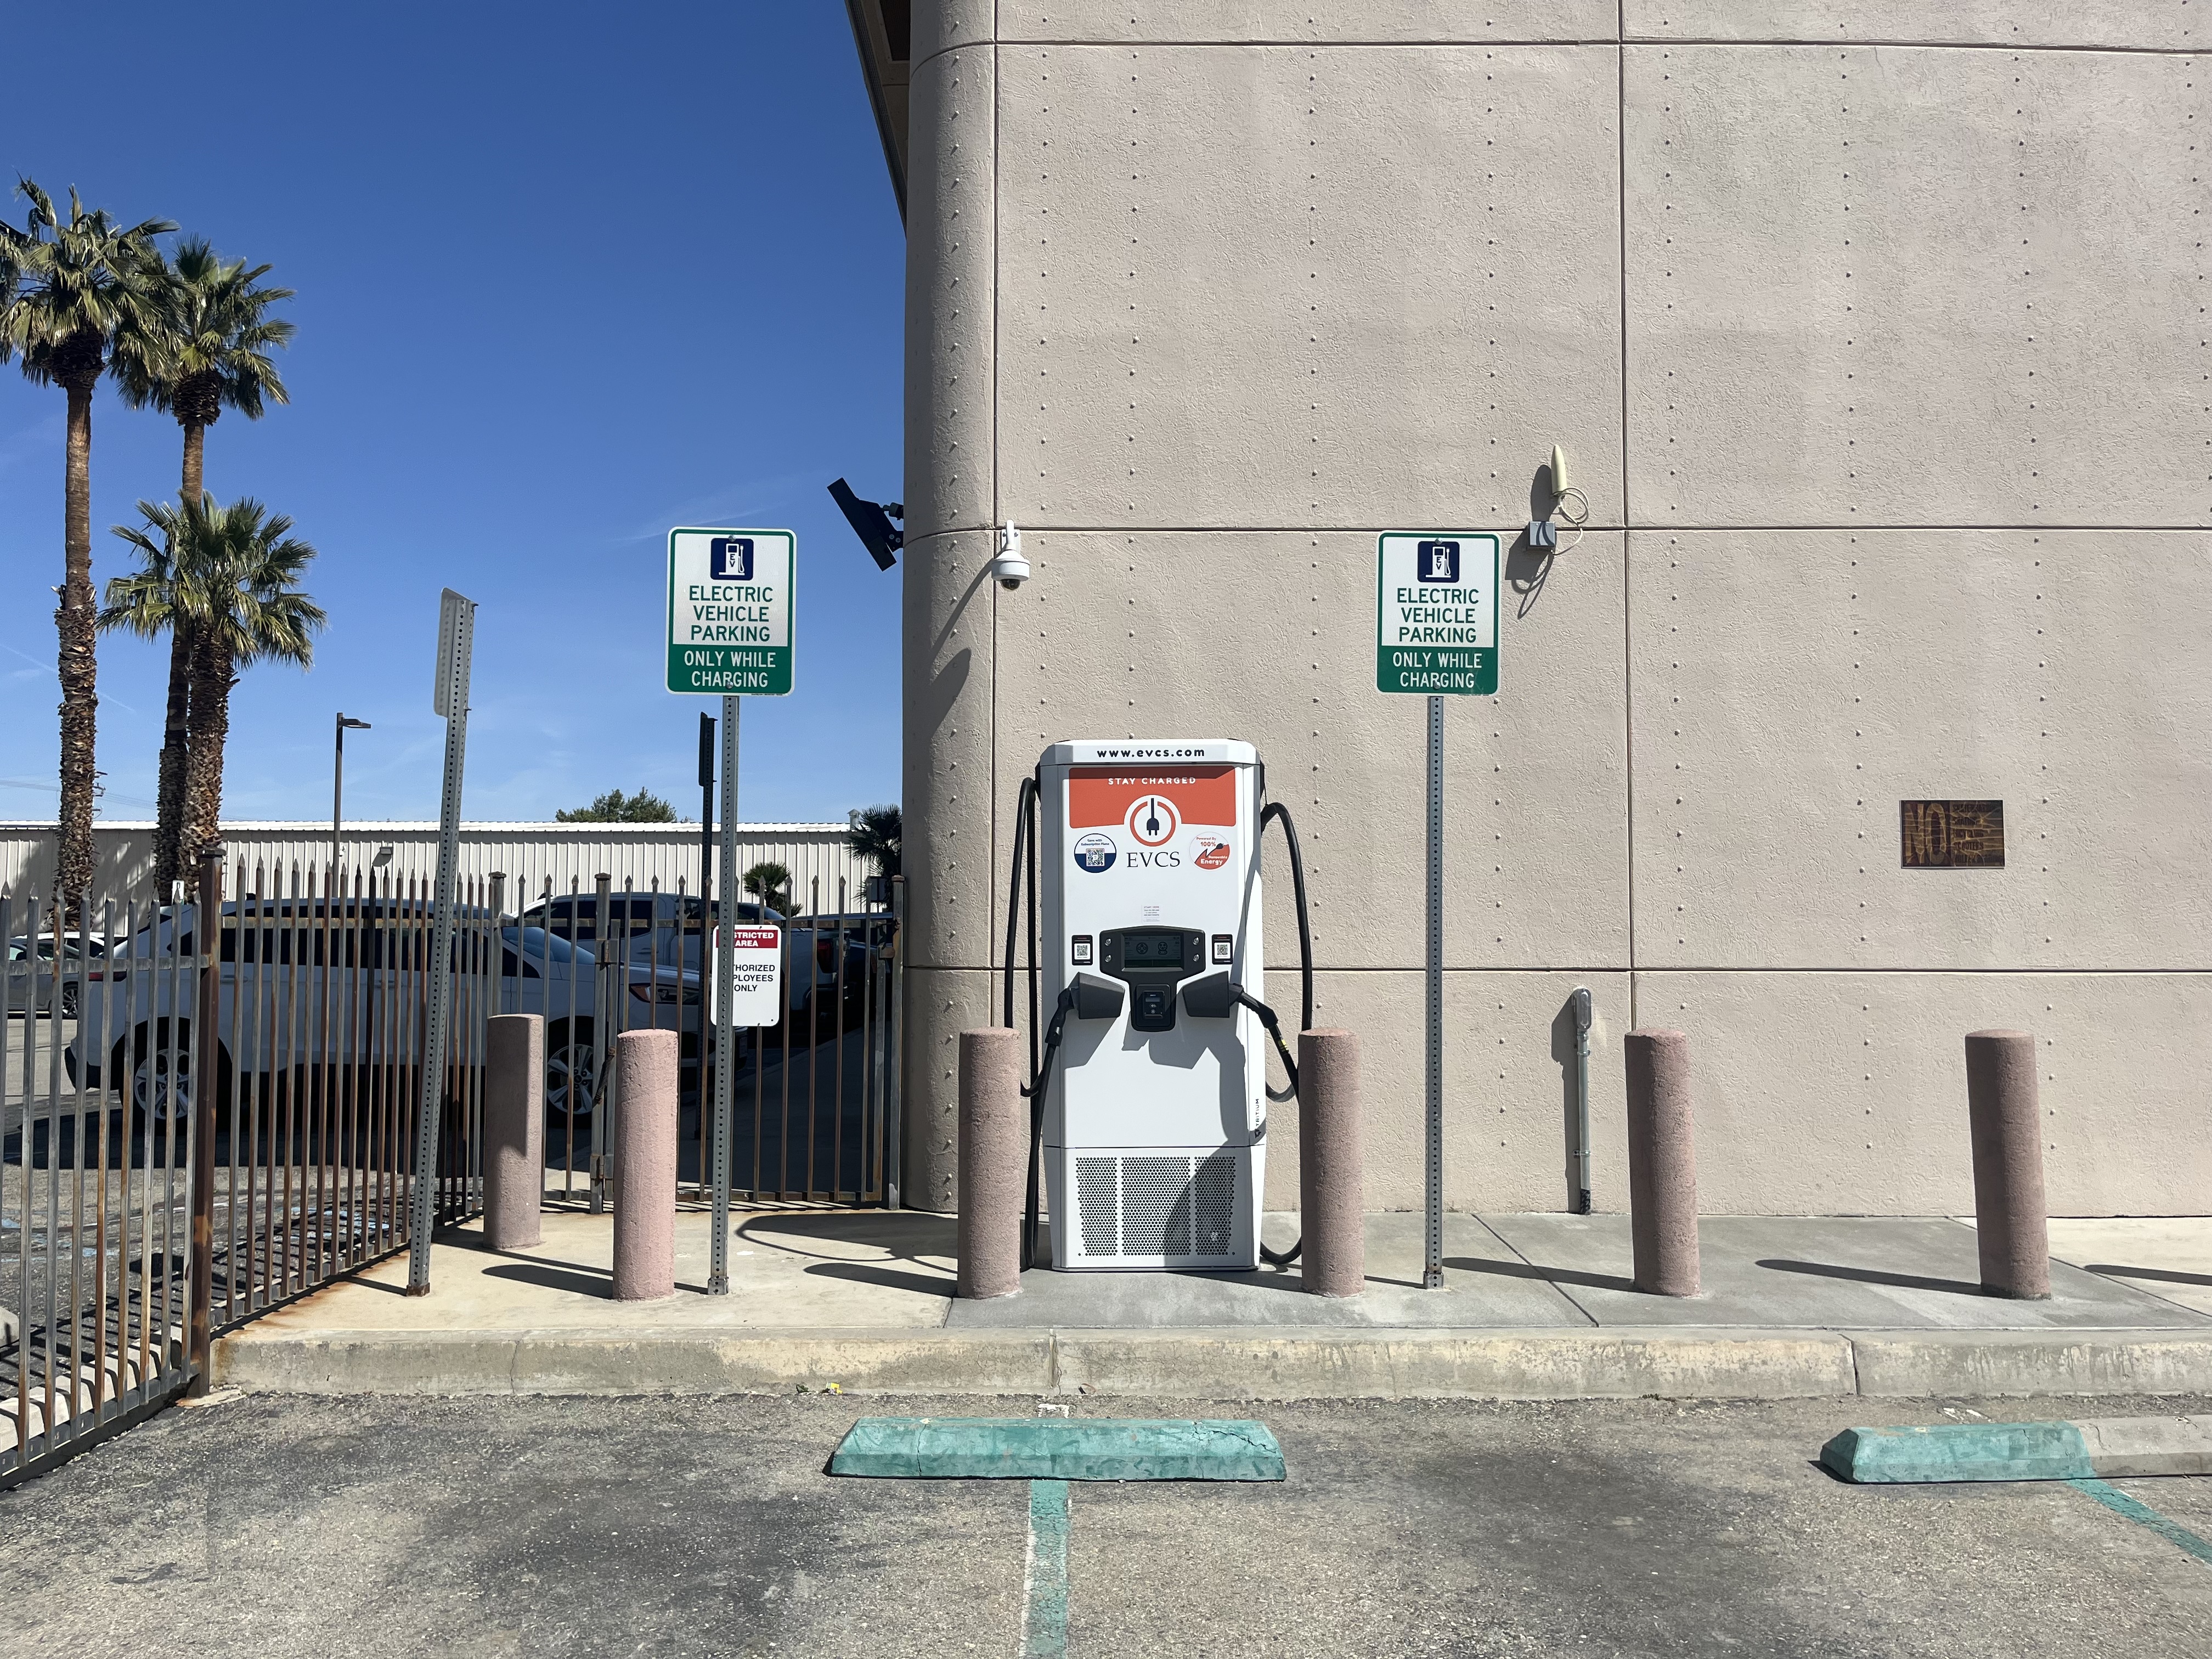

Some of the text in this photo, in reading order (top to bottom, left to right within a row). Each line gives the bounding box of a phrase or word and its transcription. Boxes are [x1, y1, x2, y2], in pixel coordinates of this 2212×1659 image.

[689, 585, 773, 602] ELECTRIC
[1397, 588, 1479, 604] ELECTRIC
[693, 605, 769, 622] VEHICLE
[1401, 607, 1476, 624] VEHICLE
[691, 625, 770, 642] PARKING
[1399, 627, 1476, 643] PARKING
[684, 650, 776, 668] ONLY WHILE
[1392, 652, 1482, 668] ONLY WHILE
[691, 671, 768, 687] CHARGING
[1400, 672, 1475, 688] CHARGING
[1097, 749, 1205, 758] www.evcs.com
[1126, 851, 1181, 868] EVCS
